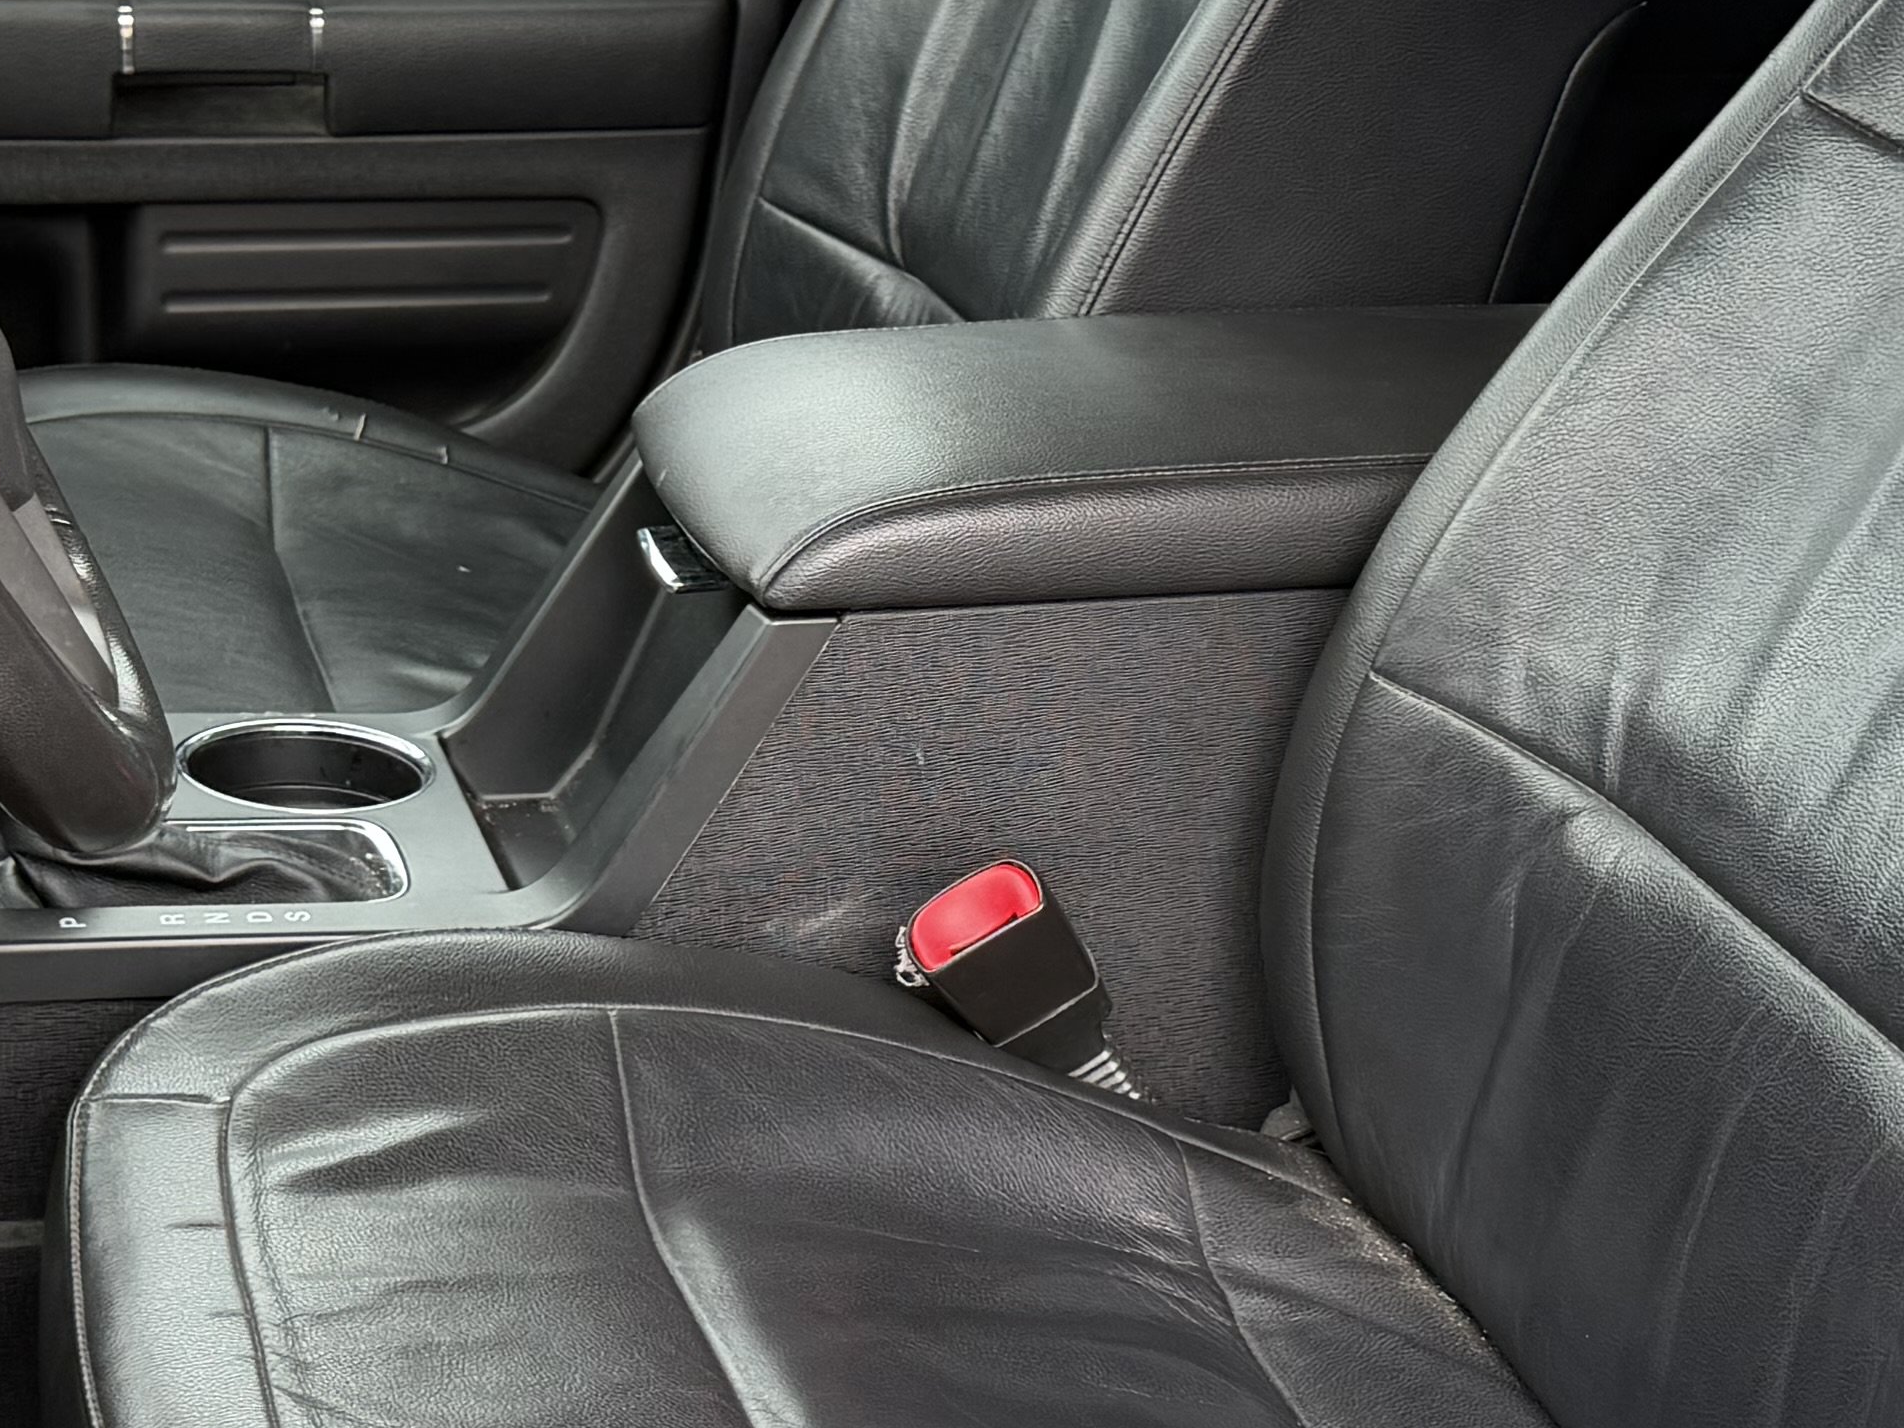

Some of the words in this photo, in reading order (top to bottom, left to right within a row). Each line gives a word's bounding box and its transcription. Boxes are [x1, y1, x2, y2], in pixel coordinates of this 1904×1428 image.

[58, 916, 87, 928] P
[159, 913, 186, 925] R
[203, 912, 231, 923] N
[246, 911, 273, 923] D
[284, 910, 311, 922] S
